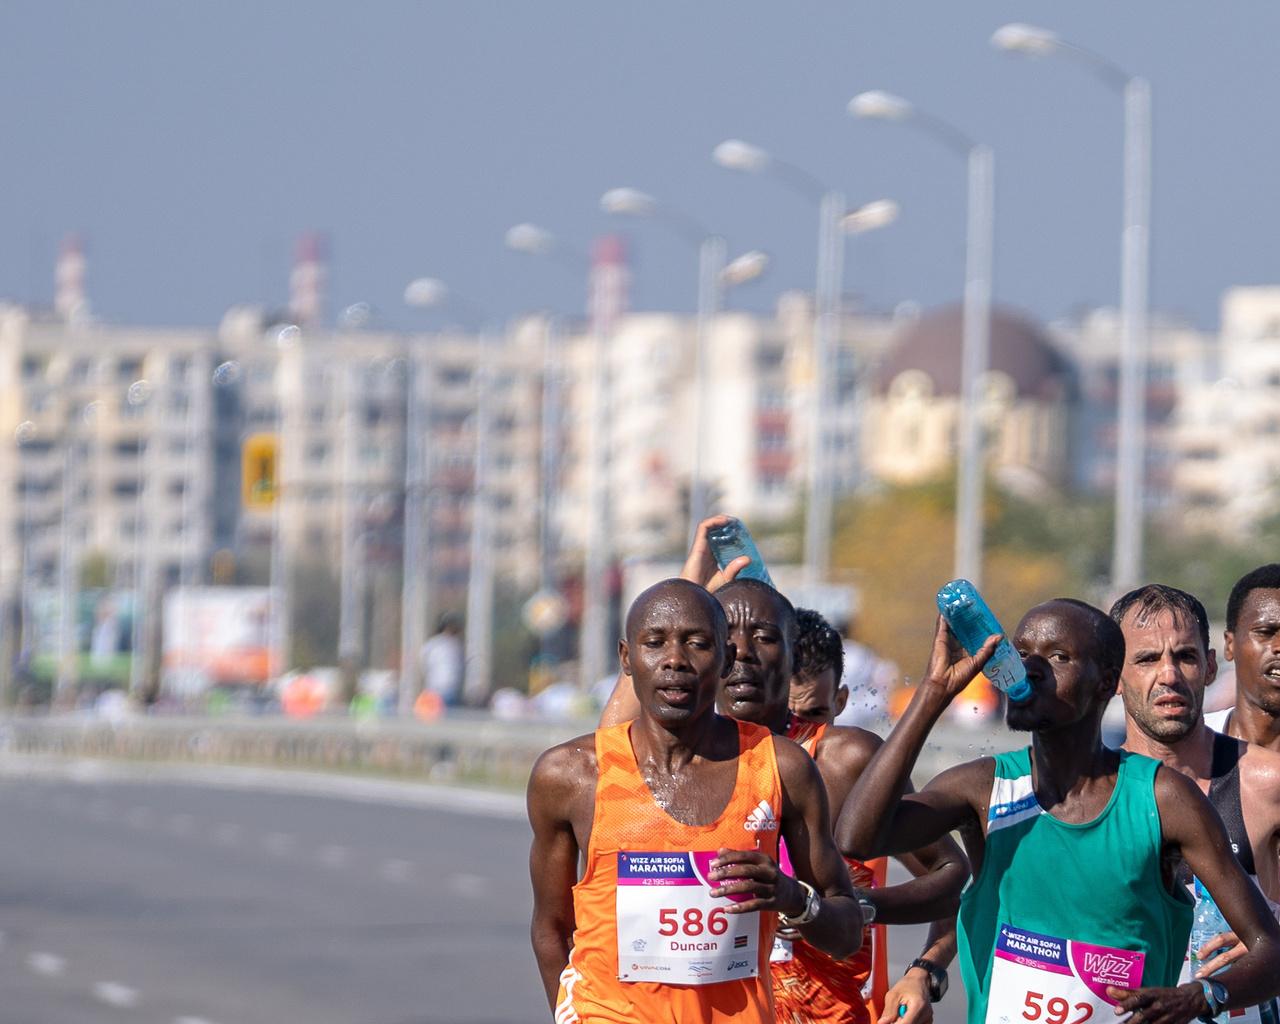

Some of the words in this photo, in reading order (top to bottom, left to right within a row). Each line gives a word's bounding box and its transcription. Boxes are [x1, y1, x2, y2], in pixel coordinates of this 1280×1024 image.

[743, 819, 777, 831] adidas
[629, 864, 685, 873] MARATHON
[657, 908, 729, 937] 586
[670, 941, 718, 952] Duncan
[1008, 932, 1026, 941] WIZZ
[1026, 937, 1039, 946] AIR
[1040, 941, 1061, 950] SOFIA
[1006, 938, 1060, 960] MARATHON
[1092, 976, 1129, 987] wizzair.com
